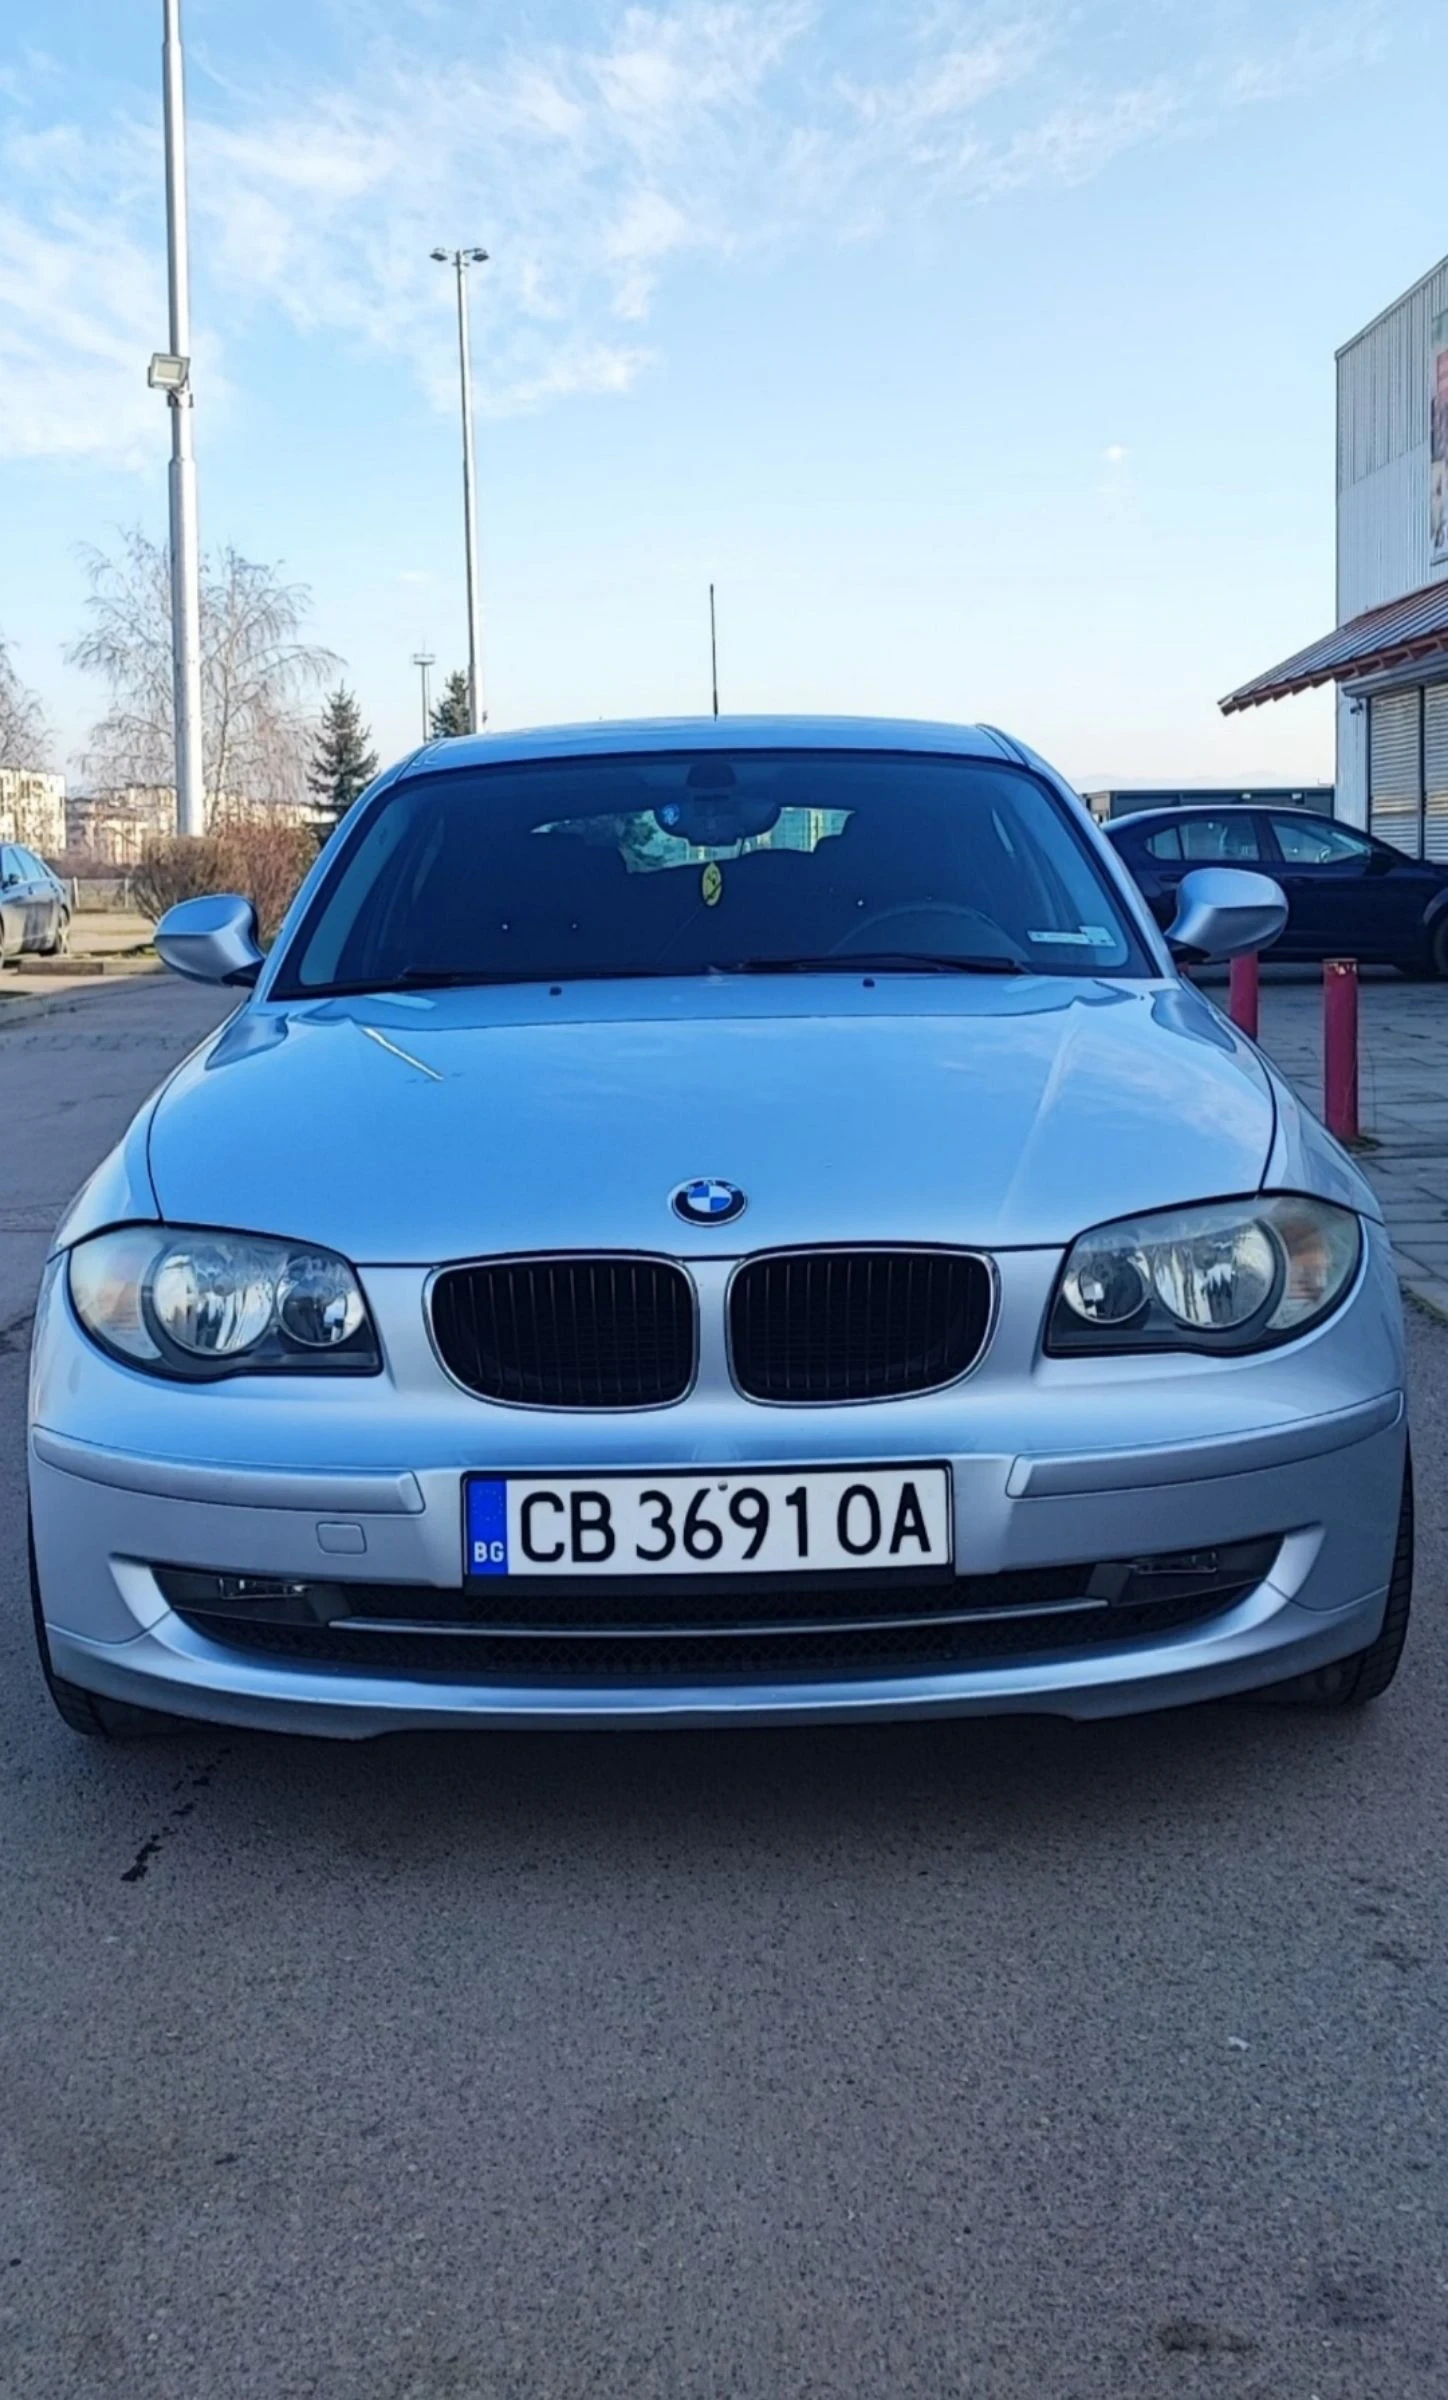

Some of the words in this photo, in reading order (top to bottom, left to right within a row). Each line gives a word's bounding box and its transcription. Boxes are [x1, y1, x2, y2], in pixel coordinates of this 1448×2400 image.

[519, 1490, 616, 1563] CB
[636, 1486, 809, 1562] 3691
[837, 1481, 932, 1556] OA
[474, 1541, 504, 1563] BG
